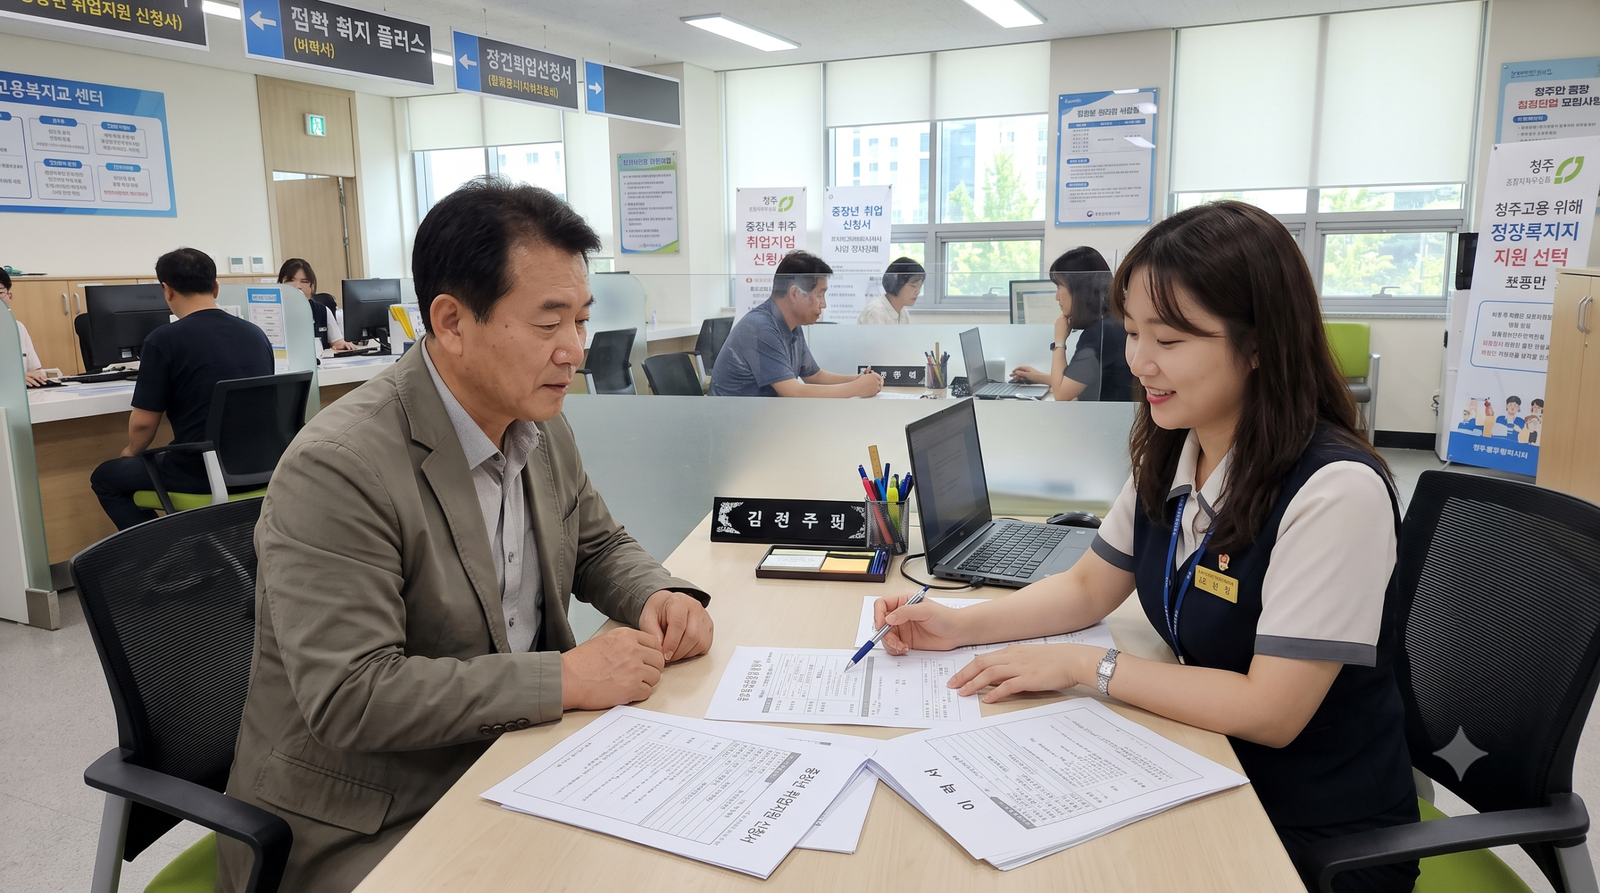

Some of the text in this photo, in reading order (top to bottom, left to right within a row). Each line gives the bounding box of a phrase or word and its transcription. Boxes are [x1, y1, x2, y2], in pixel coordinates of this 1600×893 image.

[377, 24, 427, 54] 플러스
[75, 88, 104, 107] 센터
[1530, 158, 1555, 174] 청주
[831, 205, 883, 217] 중장년 취업
[1495, 198, 1584, 218] 청주고용 위해
[746, 221, 775, 232] 중장년
[843, 219, 871, 230] 신청서
[746, 235, 795, 249] 취업지엄
[1493, 247, 1528, 268] 지원
